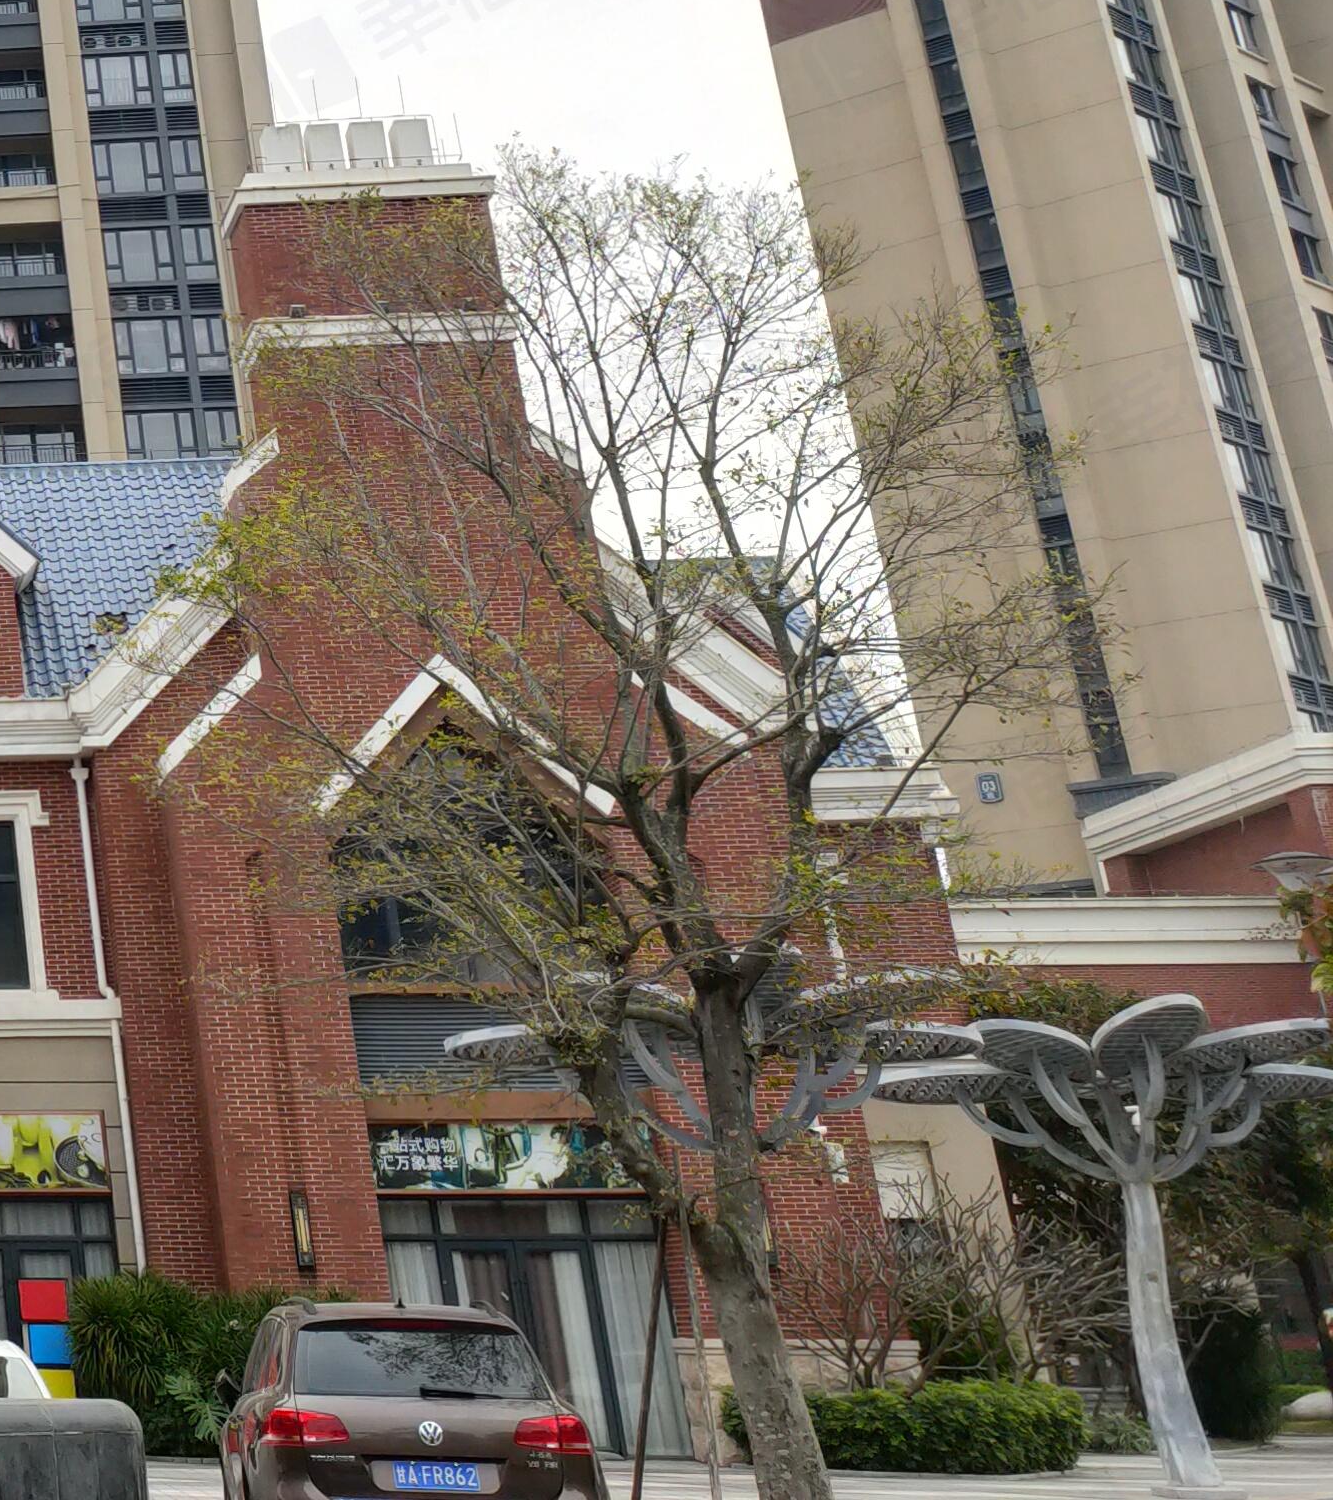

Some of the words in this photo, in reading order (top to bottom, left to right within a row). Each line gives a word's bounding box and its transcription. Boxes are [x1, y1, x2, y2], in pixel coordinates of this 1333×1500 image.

[379, 1154, 459, 1171] 汇万象繁华
